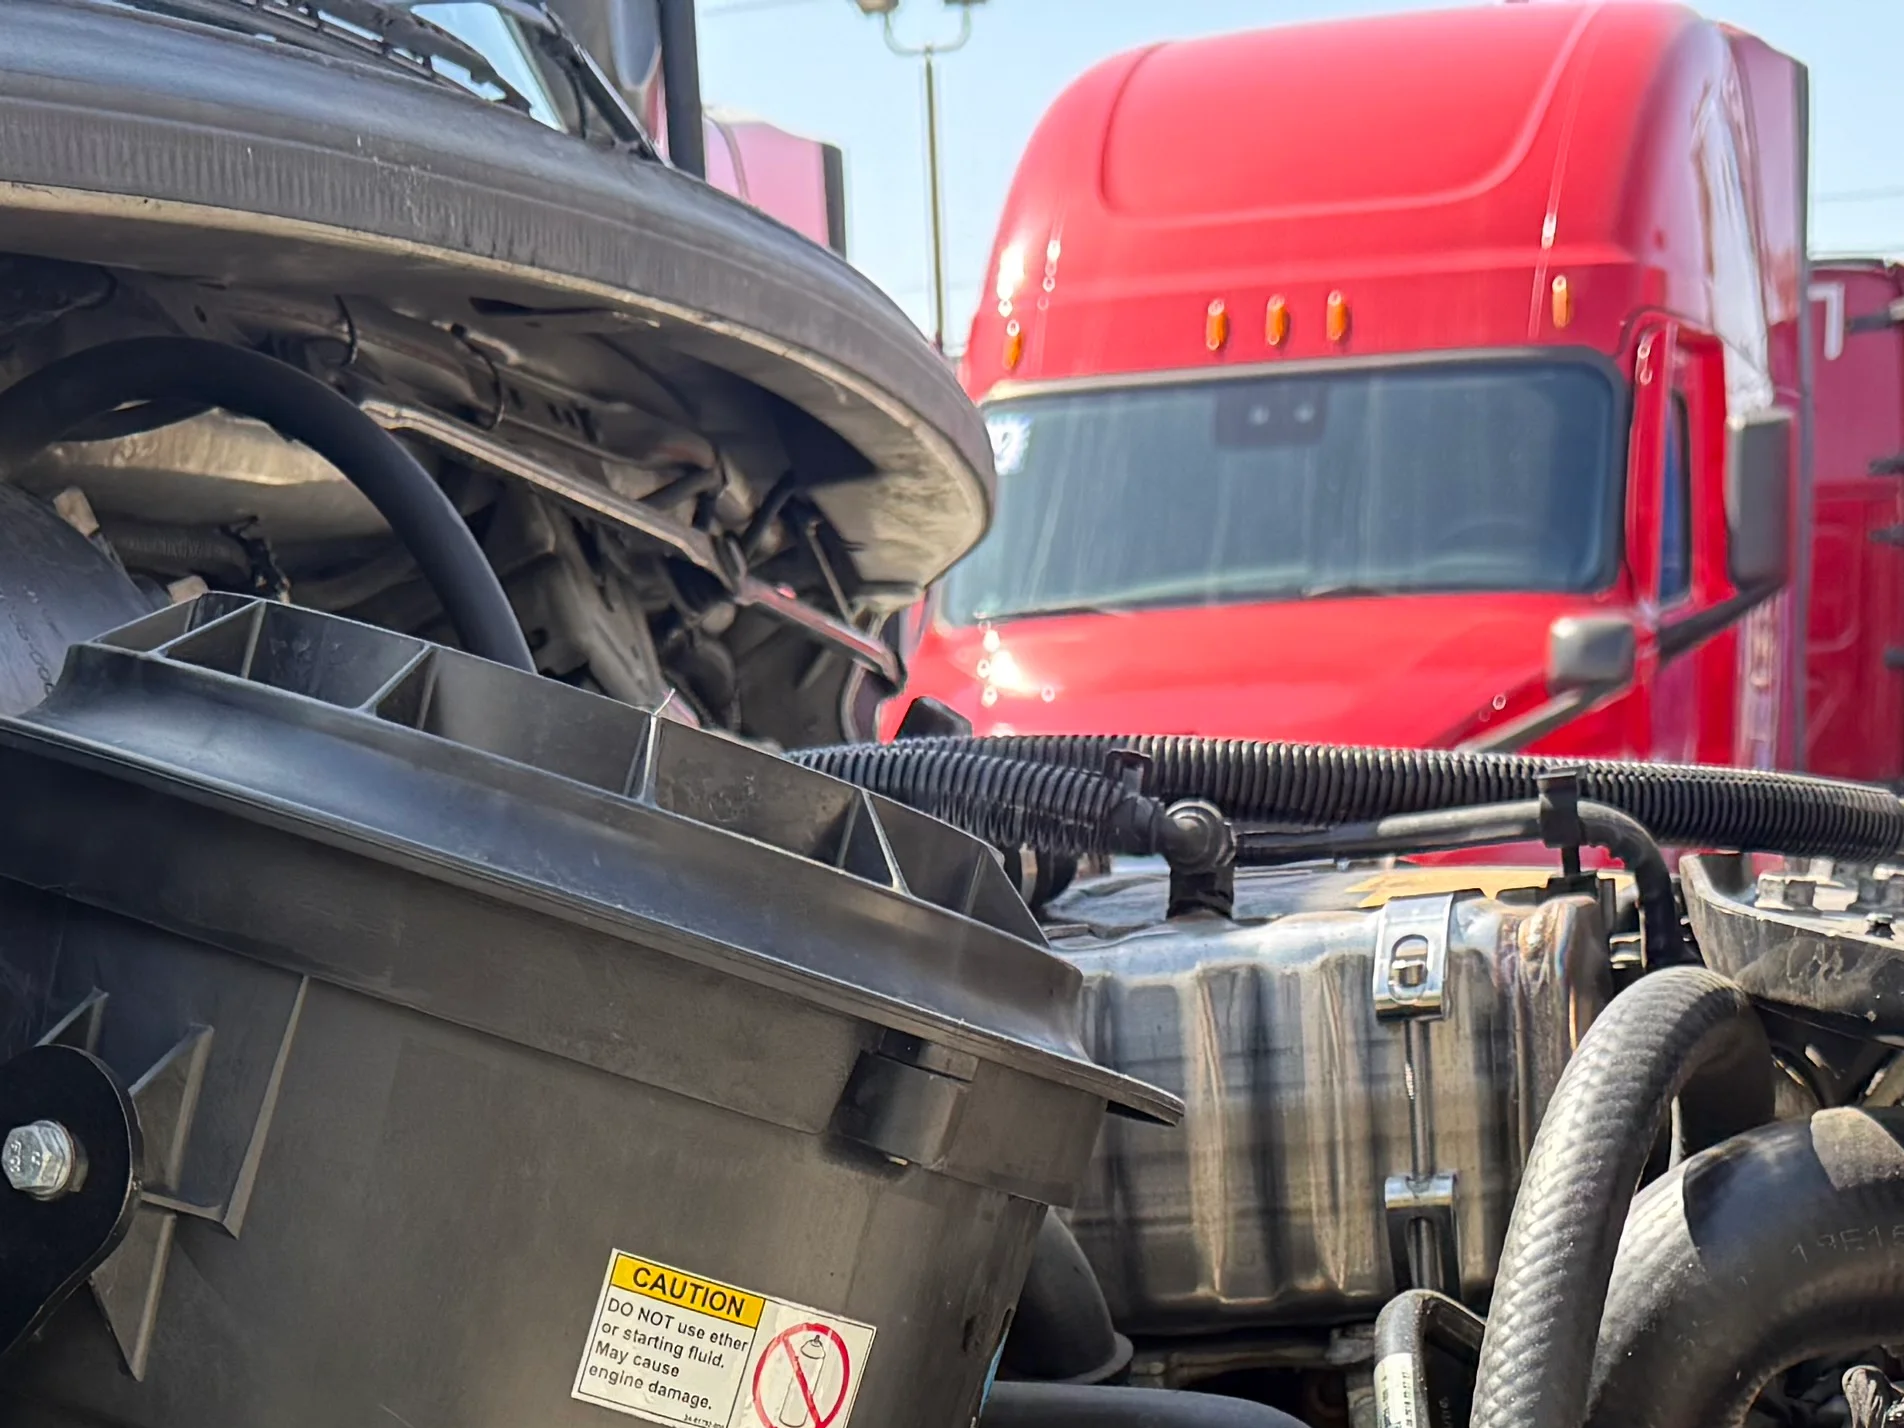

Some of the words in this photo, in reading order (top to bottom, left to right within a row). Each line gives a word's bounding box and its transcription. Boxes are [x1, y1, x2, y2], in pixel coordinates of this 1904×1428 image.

[633, 1267, 745, 1317] CAUTION
[602, 1323, 619, 1334] or
[623, 1328, 683, 1358] starting
[688, 1346, 725, 1368] fluid.
[607, 1298, 633, 1316] DO
[638, 1307, 674, 1329] NOT
[678, 1322, 705, 1339] use
[710, 1332, 748, 1351] ether
[595, 1341, 628, 1366] May
[633, 1356, 679, 1377] cause
[589, 1365, 643, 1391] engine
[648, 1381, 712, 1411] damage.
